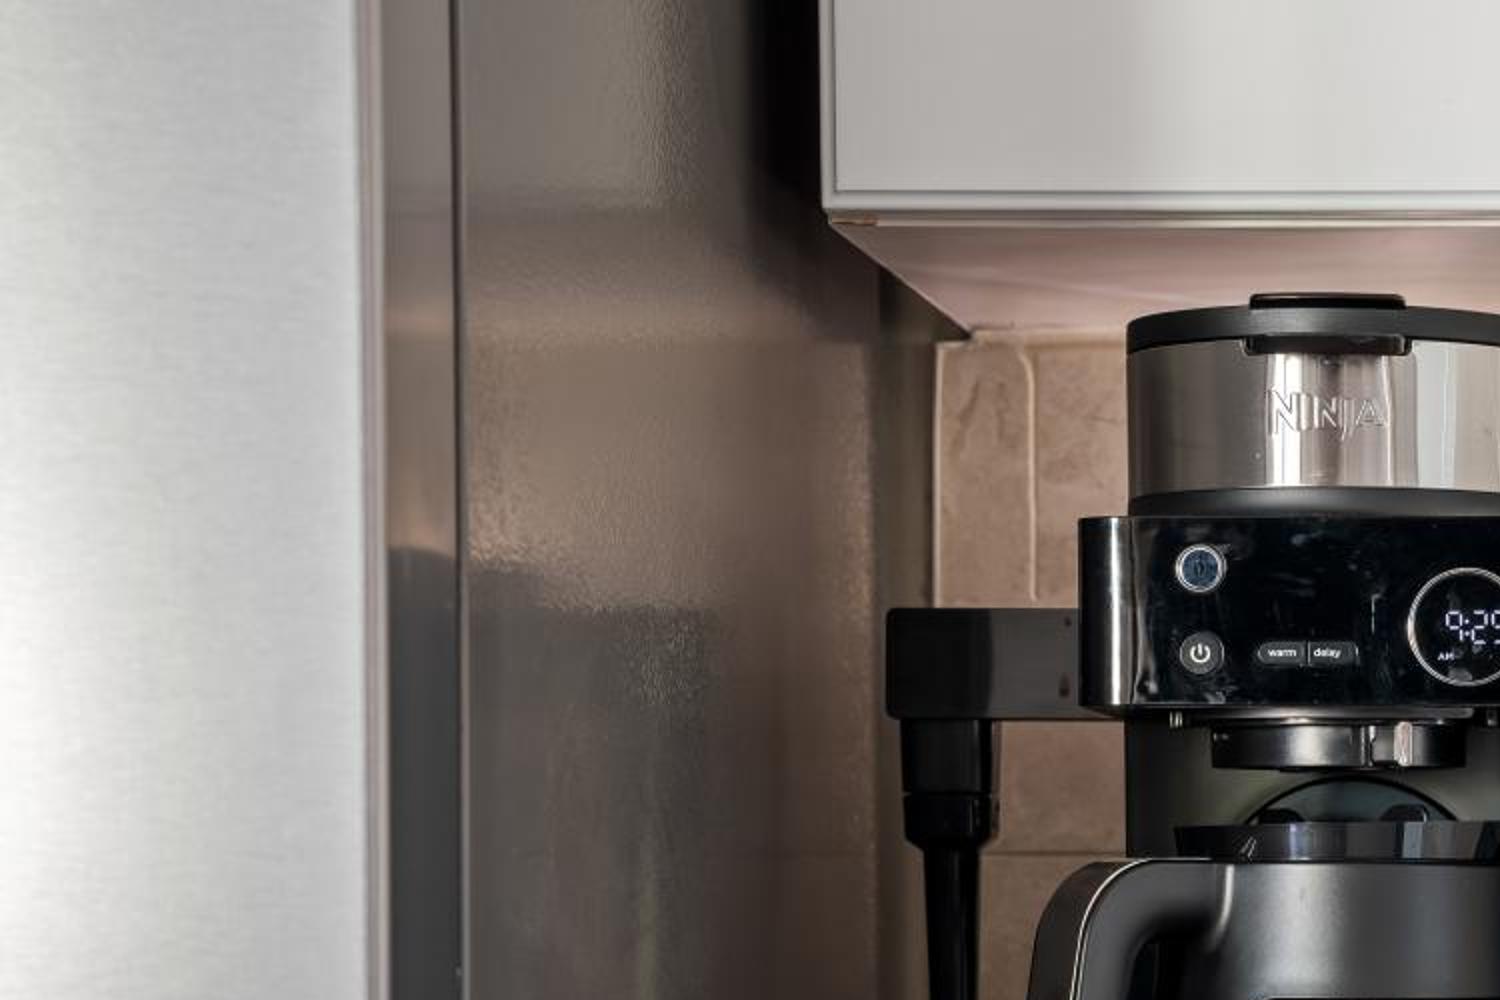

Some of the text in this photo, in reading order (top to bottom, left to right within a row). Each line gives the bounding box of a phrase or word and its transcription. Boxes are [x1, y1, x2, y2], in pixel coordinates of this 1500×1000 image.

[1265, 389, 1387, 441] NINJA
[1267, 647, 1341, 659] warm delay
[1437, 651, 1455, 661] AM
